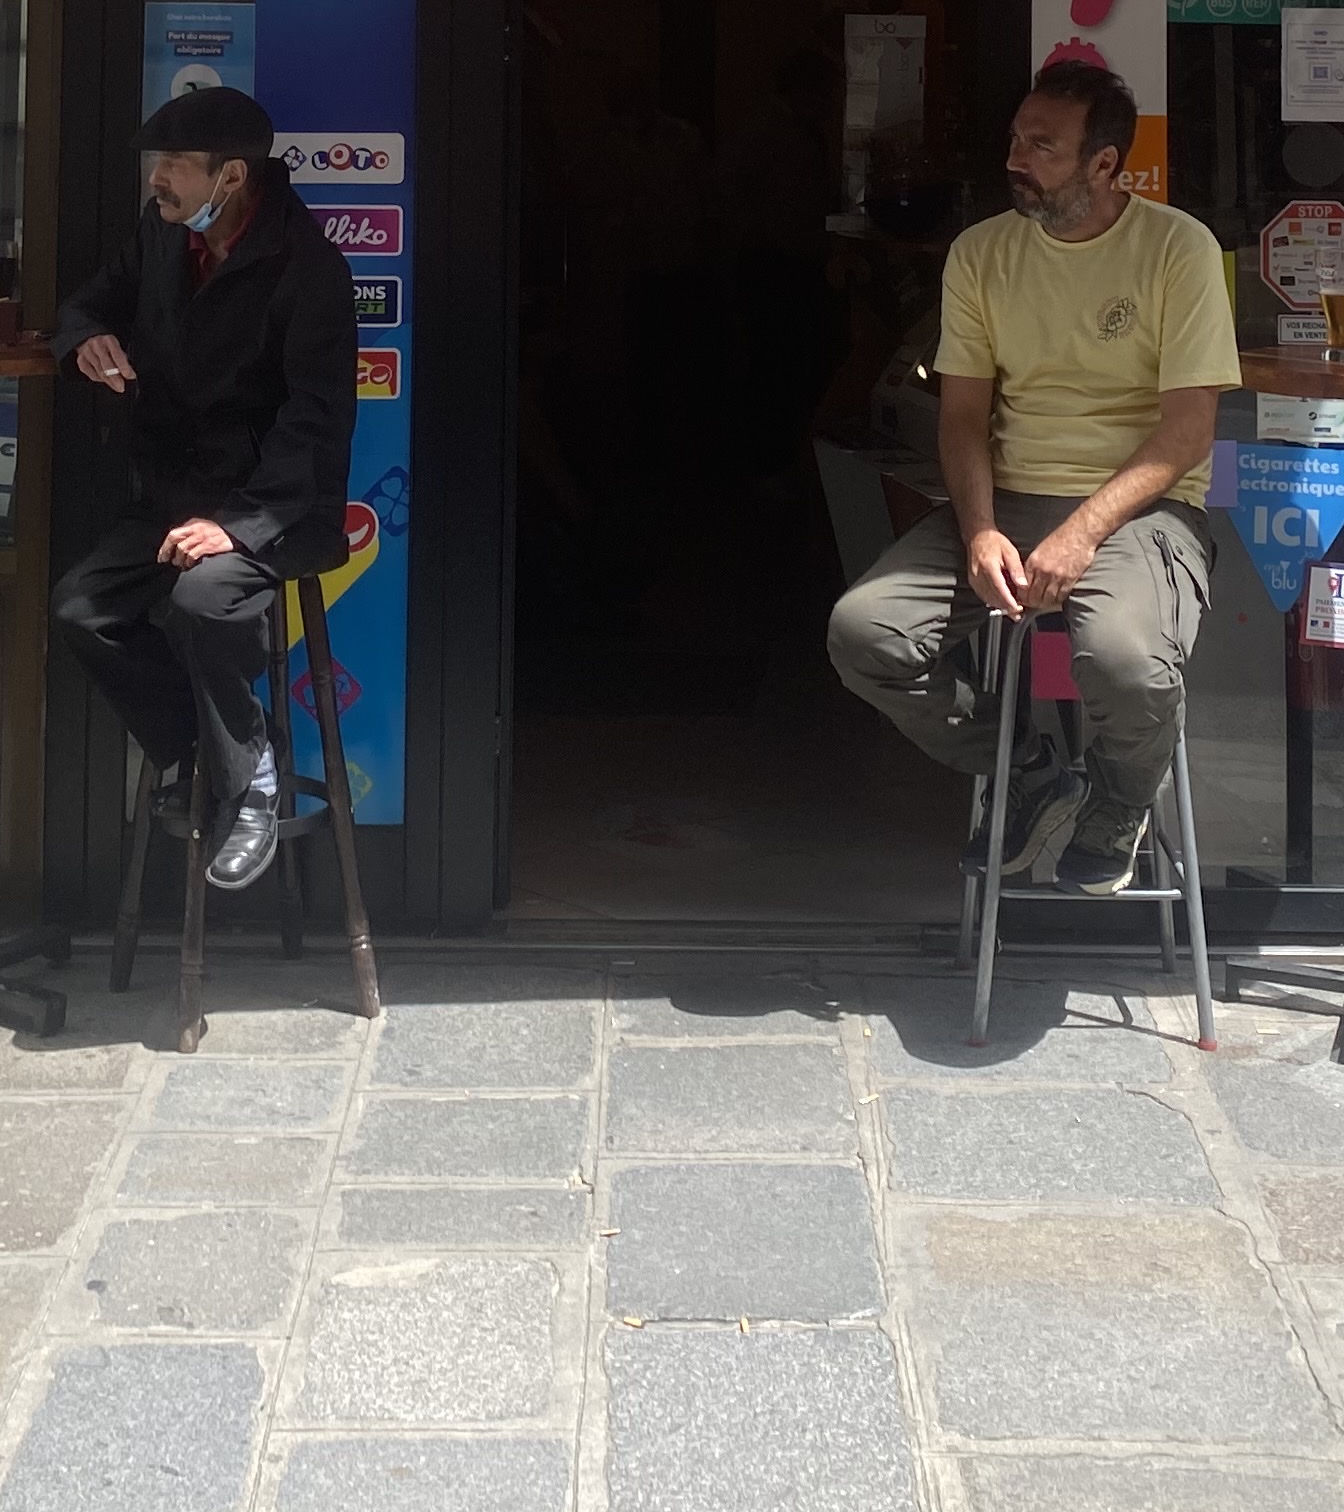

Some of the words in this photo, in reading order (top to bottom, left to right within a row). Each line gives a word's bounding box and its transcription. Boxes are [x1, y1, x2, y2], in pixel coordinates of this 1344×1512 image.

[176, 45, 222, 55] obligatoire
[312, 143, 390, 170] LOTO
[1111, 165, 1160, 191] ez!
[1298, 205, 1333, 218] STOP
[324, 214, 388, 246] lliko
[1293, 331, 1304, 339] EN
[1238, 453, 1340, 475] Cigarettes
[1253, 505, 1320, 548] ICI
[1271, 561, 1297, 591] blu
